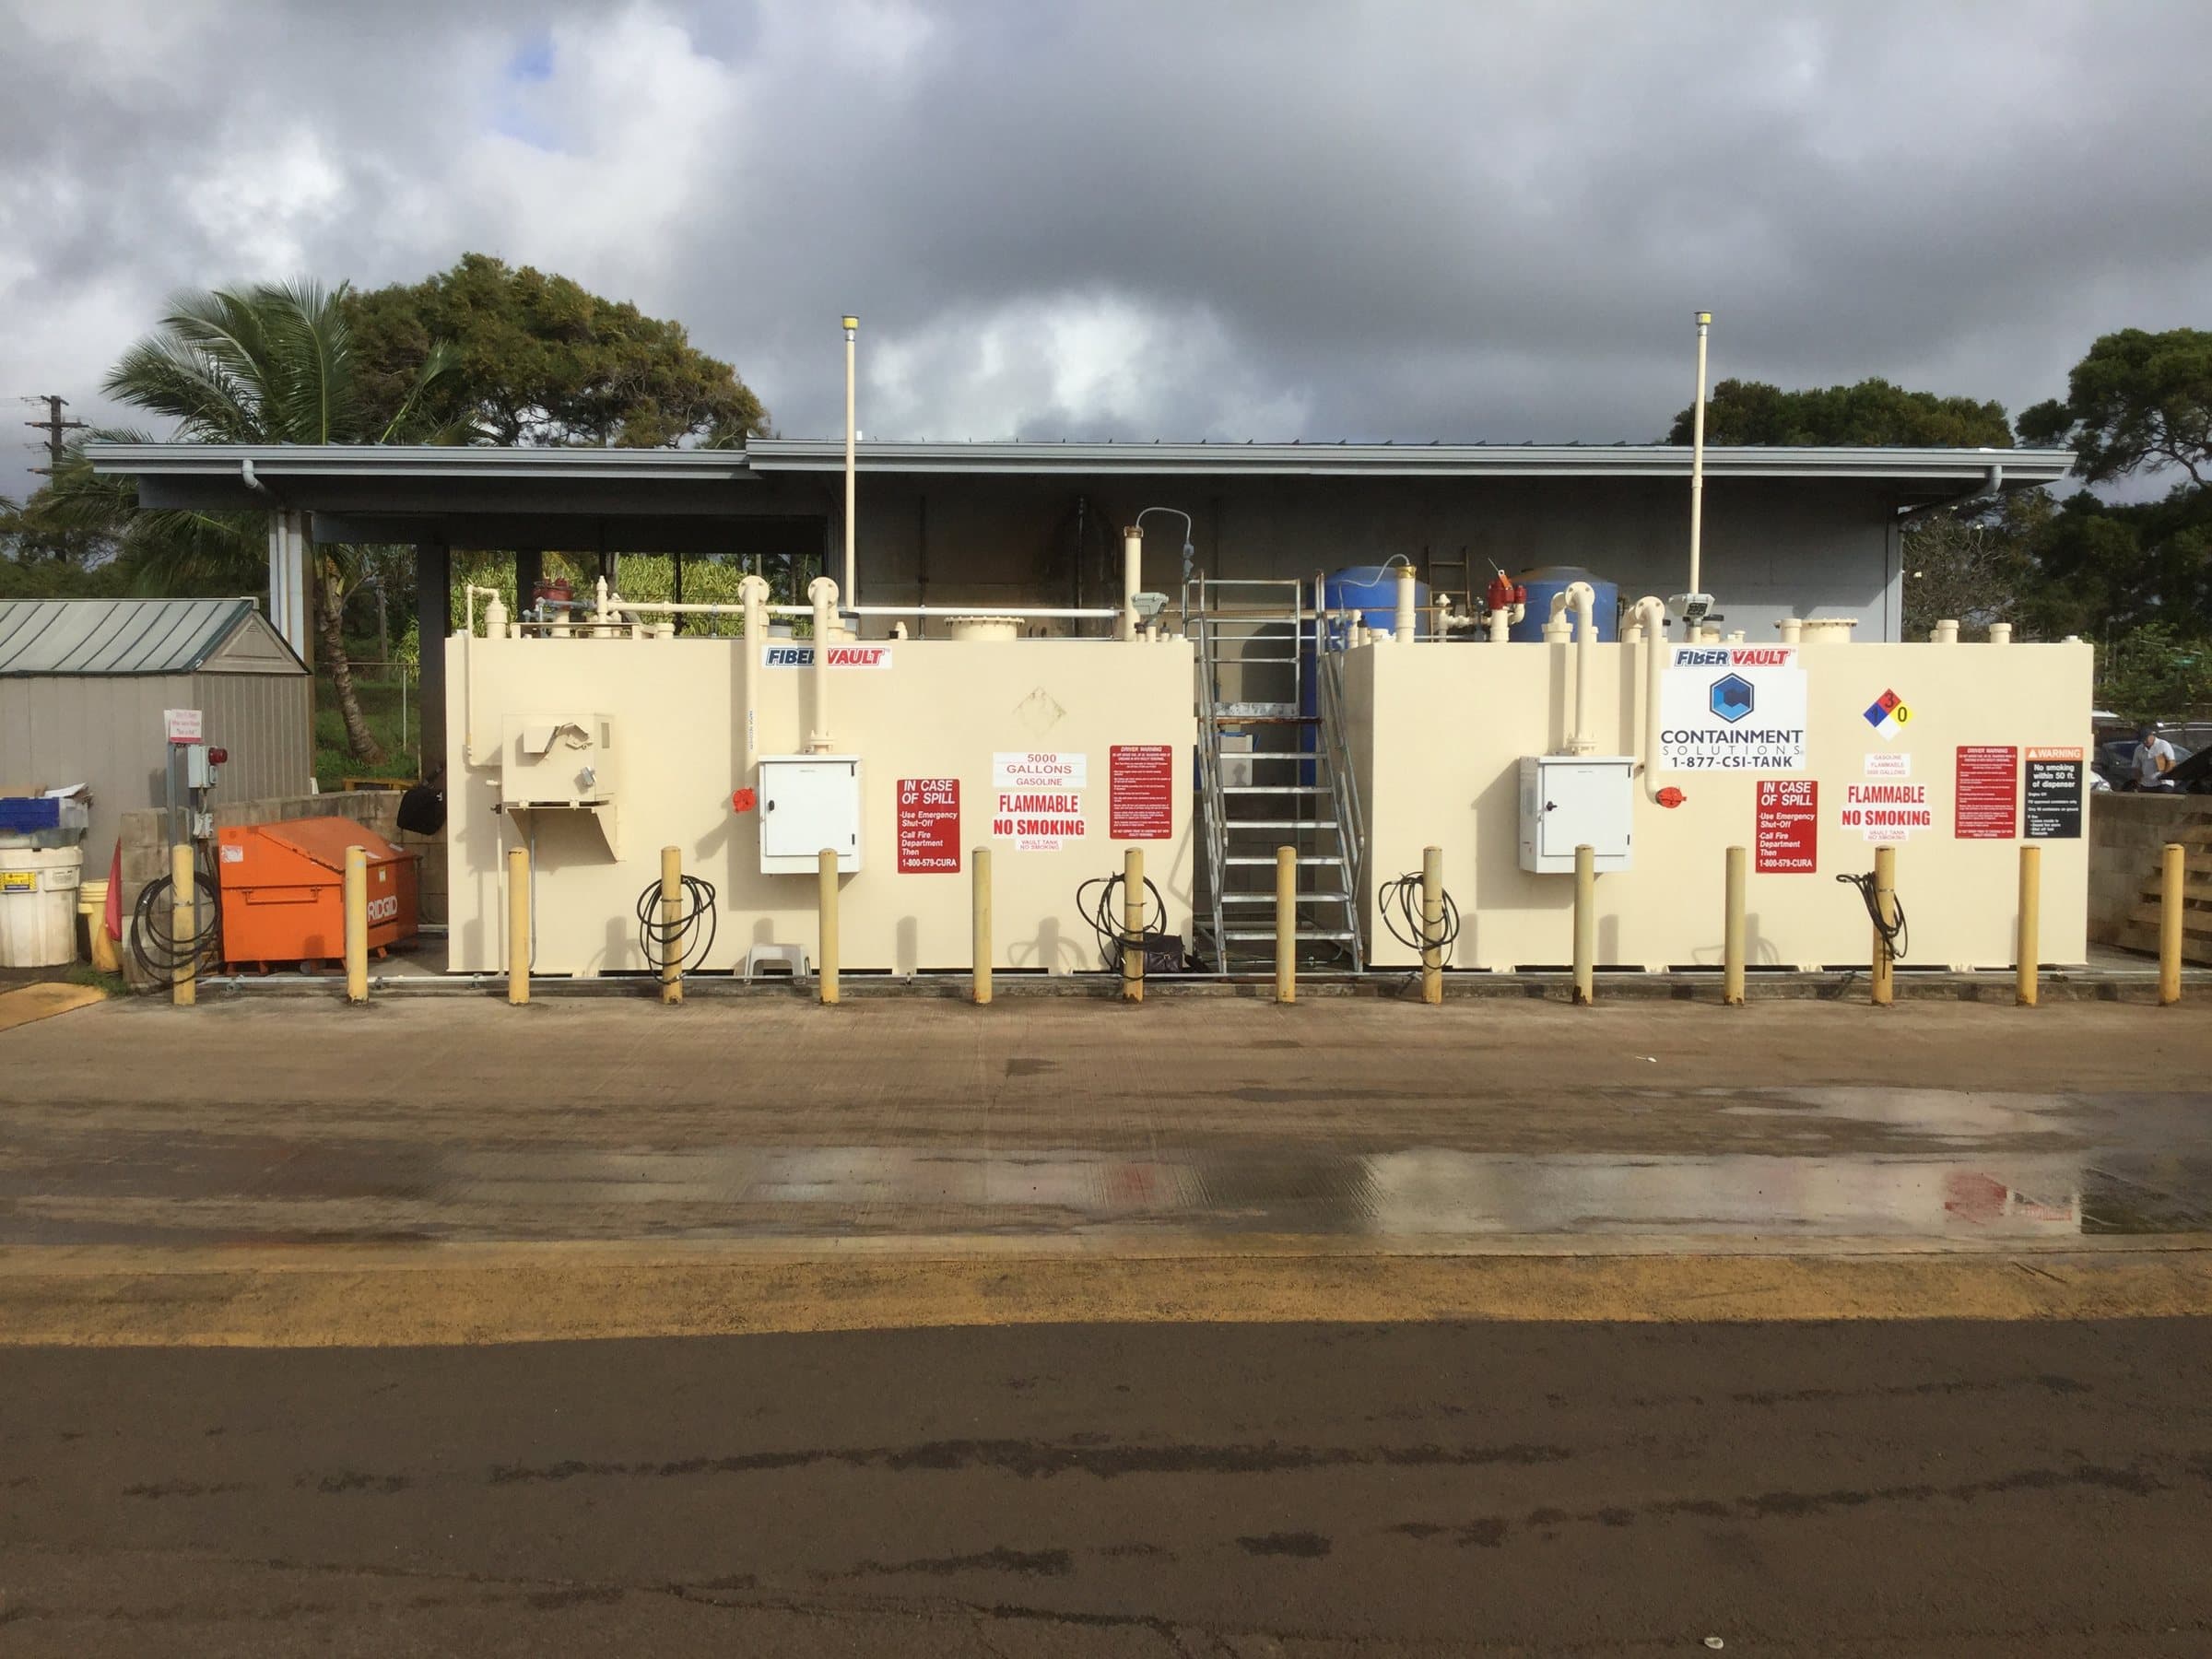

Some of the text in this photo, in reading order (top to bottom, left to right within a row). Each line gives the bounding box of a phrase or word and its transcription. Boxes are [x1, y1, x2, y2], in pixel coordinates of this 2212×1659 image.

[828, 649, 883, 665] VAULT
[1676, 650, 1789, 665] FIBER VAULT
[1884, 692, 1895, 709] 3
[1897, 706, 1908, 723] 0
[1660, 729, 1804, 744] CONTAINMENT
[1663, 745, 1801, 756] SOLUTIONS
[2038, 748, 2081, 759] WARNING
[1027, 753, 1057, 763] 5000
[1671, 756, 1794, 768] 1-877-CSI-TANK
[1006, 764, 1073, 774] GALLONS
[903, 780, 954, 792] IN CASE
[1016, 777, 1063, 786] GASOLINE
[1763, 782, 1812, 793] IN CASE
[901, 793, 956, 805] OF SPILL
[1760, 794, 1813, 806] OF SPILL
[1848, 785, 1925, 804] FLAMMABLE
[999, 794, 1078, 813] FLAMMABLE
[918, 811, 959, 820] Emergency
[1776, 812, 1816, 821] Emergency
[1841, 809, 1931, 826] NO SMOKING
[994, 818, 1085, 836] NO SMOKING
[1760, 820, 1791, 829] Shut-Off
[901, 840, 944, 848] Department
[1759, 841, 1801, 849] Department
